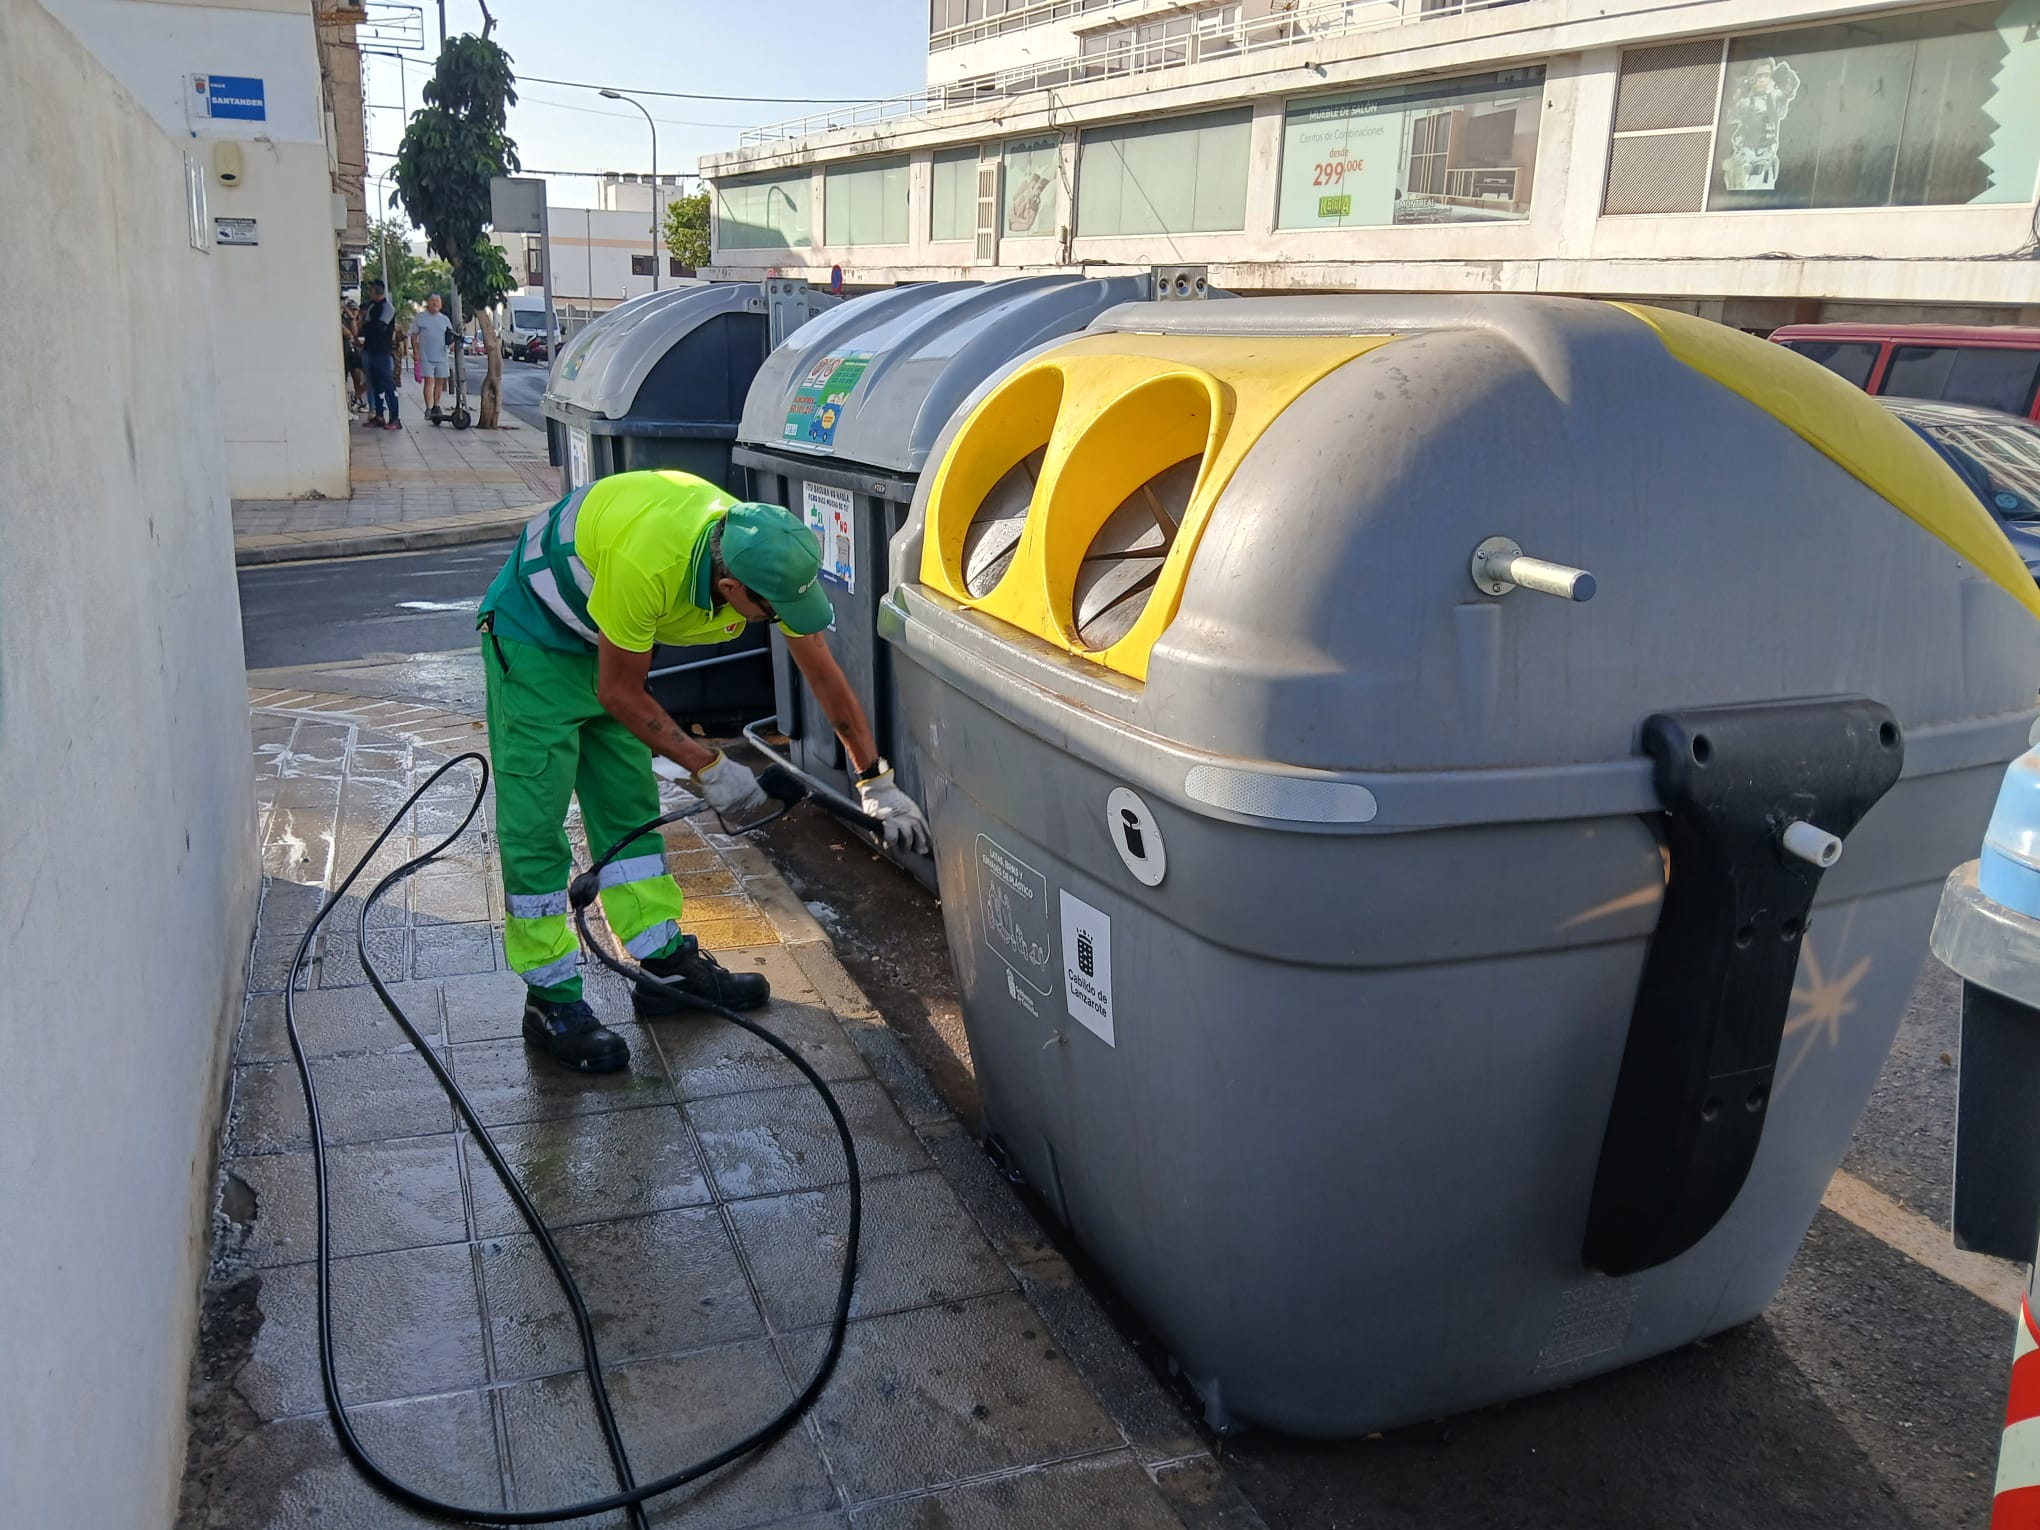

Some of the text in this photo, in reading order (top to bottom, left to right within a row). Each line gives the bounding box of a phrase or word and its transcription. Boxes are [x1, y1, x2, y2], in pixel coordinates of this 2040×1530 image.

[211, 97, 263, 106] SANTANDER
[1309, 101, 1377, 120] MUEBLE DE SALÓN
[1324, 131, 1333, 140] de
[1334, 126, 1384, 139] Combinaciones
[1329, 147, 1349, 157] desde
[840, 520, 848, 534] NO
[1068, 968, 1108, 1004] Cabildo de
[1070, 981, 1107, 1018] Lanzarote
